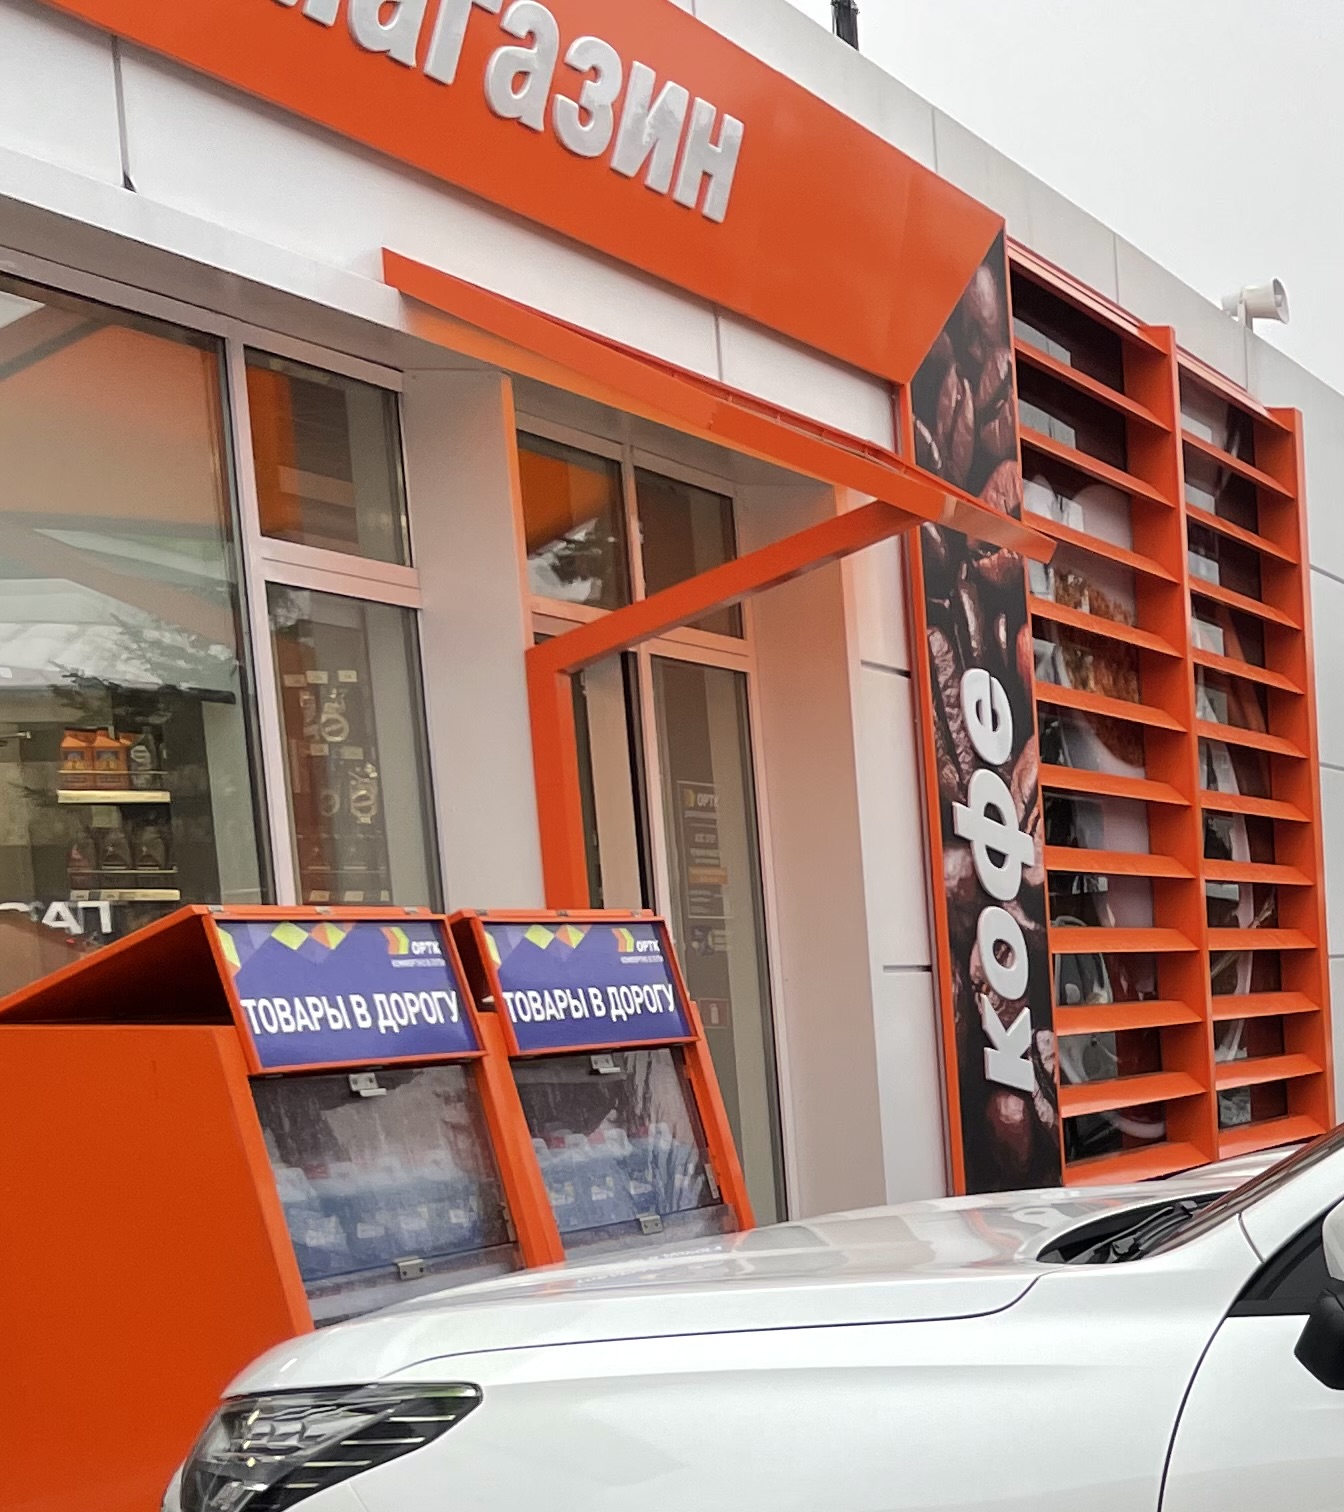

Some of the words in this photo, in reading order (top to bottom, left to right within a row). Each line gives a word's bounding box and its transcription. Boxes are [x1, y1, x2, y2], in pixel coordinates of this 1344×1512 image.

[276, 0, 744, 224] газин
[952, 668, 1035, 1093] кофе
[240, 995, 351, 1034] ТОВАРЫ
[349, 994, 372, 1028] В
[373, 991, 460, 1034] ДОРОГУ
[502, 988, 589, 1023] ТОВАРЫ
[588, 986, 606, 1017] В
[607, 984, 675, 1022] ДОРОГУ
